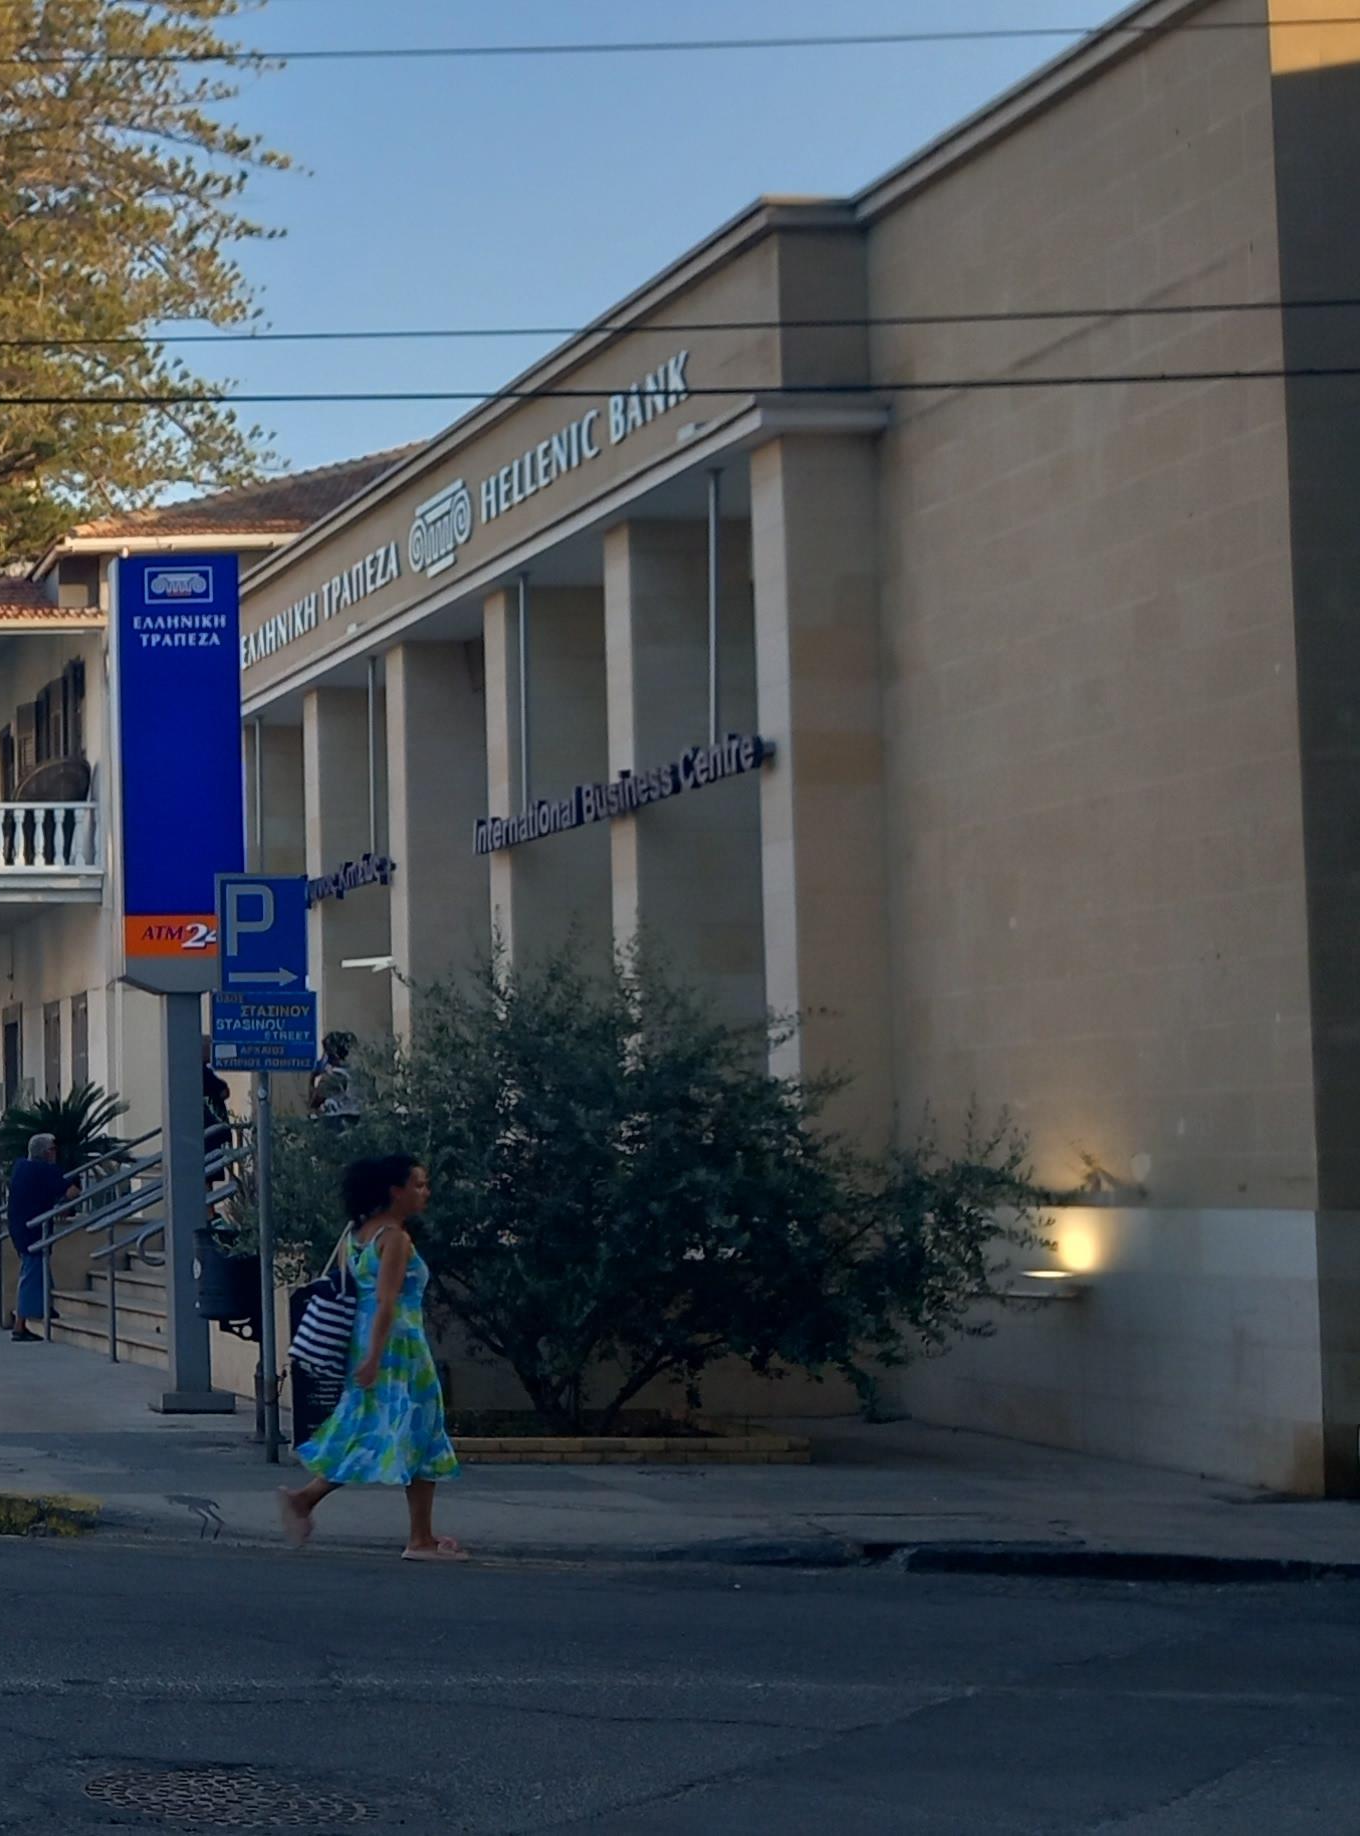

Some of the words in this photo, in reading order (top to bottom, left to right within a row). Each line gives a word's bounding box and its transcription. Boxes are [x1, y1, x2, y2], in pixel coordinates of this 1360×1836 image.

[480, 408, 601, 524] HELLENIC
[609, 350, 689, 445] BANK
[240, 591, 318, 670] ΕΛΛΗΝΙΚΗ
[322, 541, 401, 620] ΤΡΑΠΕΖΑ
[133, 614, 227, 630] ΕΛΛΗΝΙΚΗ
[140, 632, 221, 647] ΤΡΑΠΕΖΑ
[473, 787, 577, 855] International
[581, 764, 673, 822] Business
[679, 734, 754, 786] Centre
[226, 884, 274, 956] P
[240, 1005, 310, 1017] ΣΤΑΣΙΝΟΥ
[216, 1018, 286, 1031] STASINOU
[264, 1031, 311, 1041] STREET
